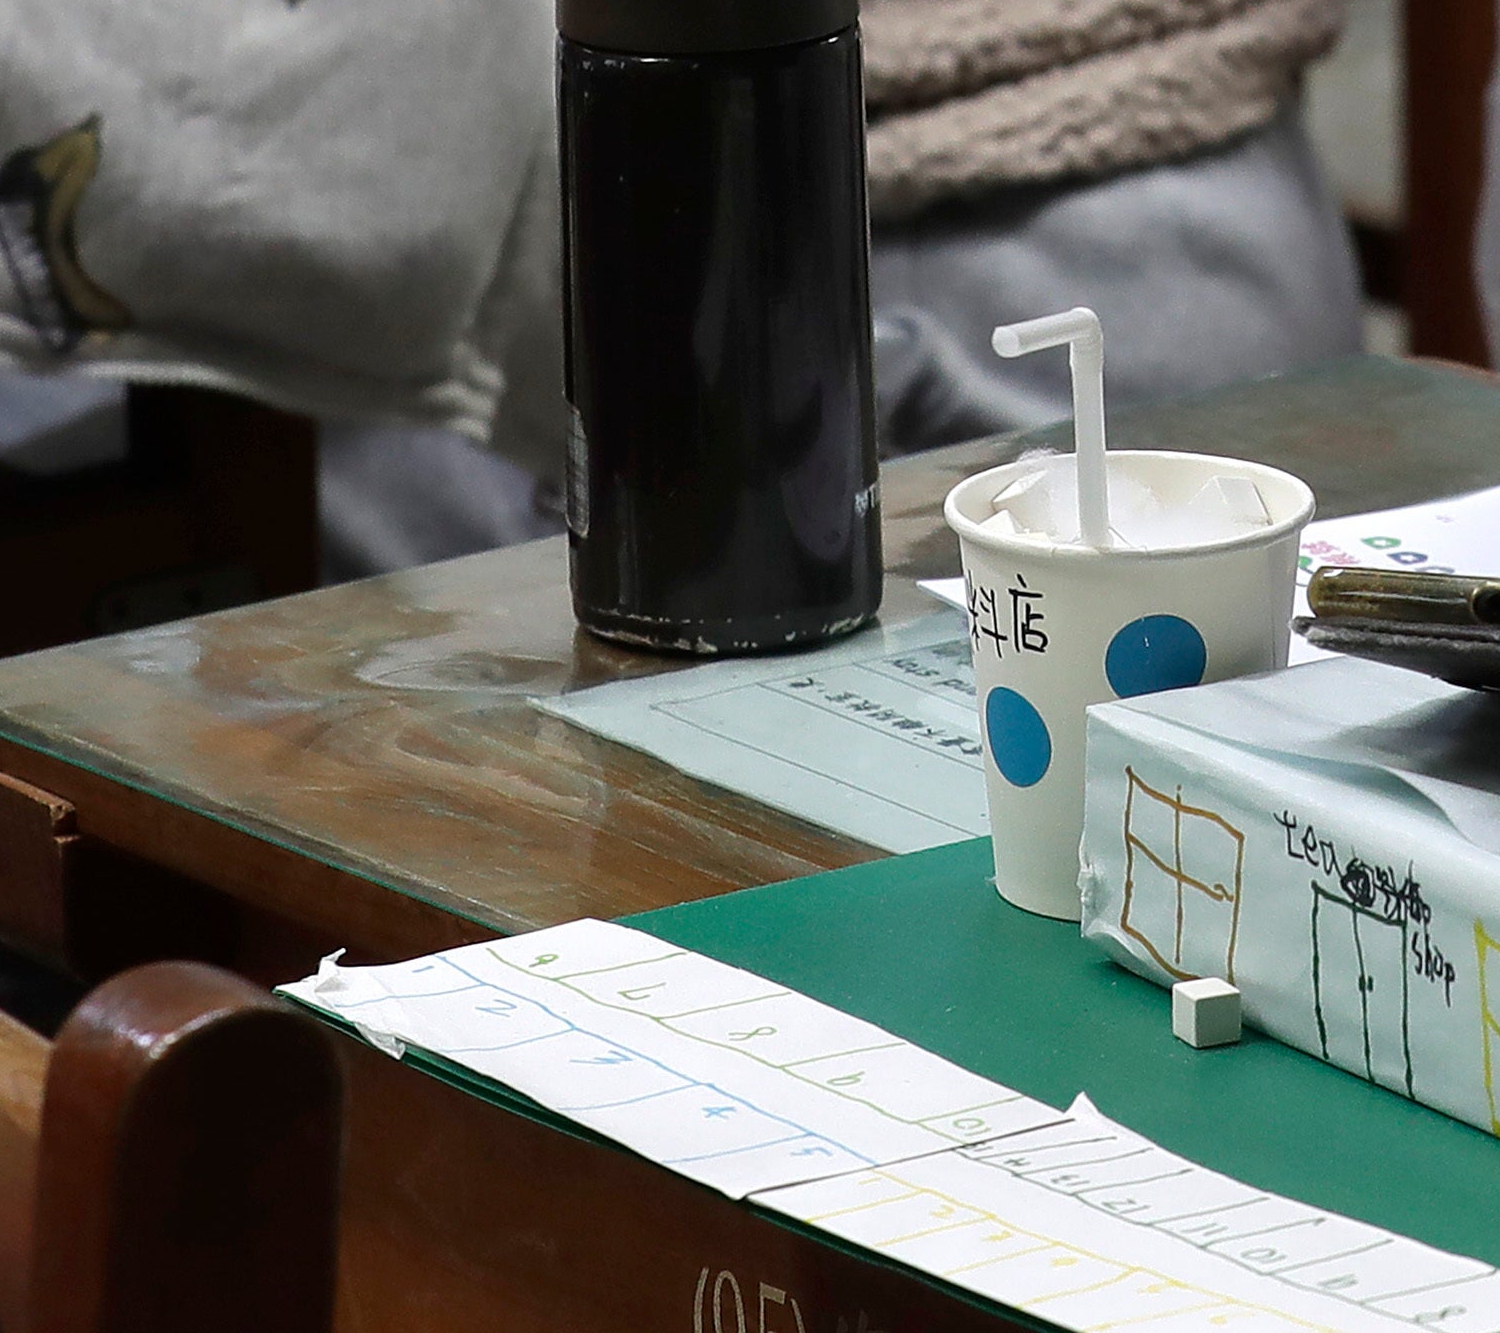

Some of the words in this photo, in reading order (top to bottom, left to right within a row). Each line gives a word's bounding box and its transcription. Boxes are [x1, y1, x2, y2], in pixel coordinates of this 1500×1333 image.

[1273, 810, 1343, 876] tea
[474, 998, 519, 1019] 2
[727, 1025, 779, 1043] 8
